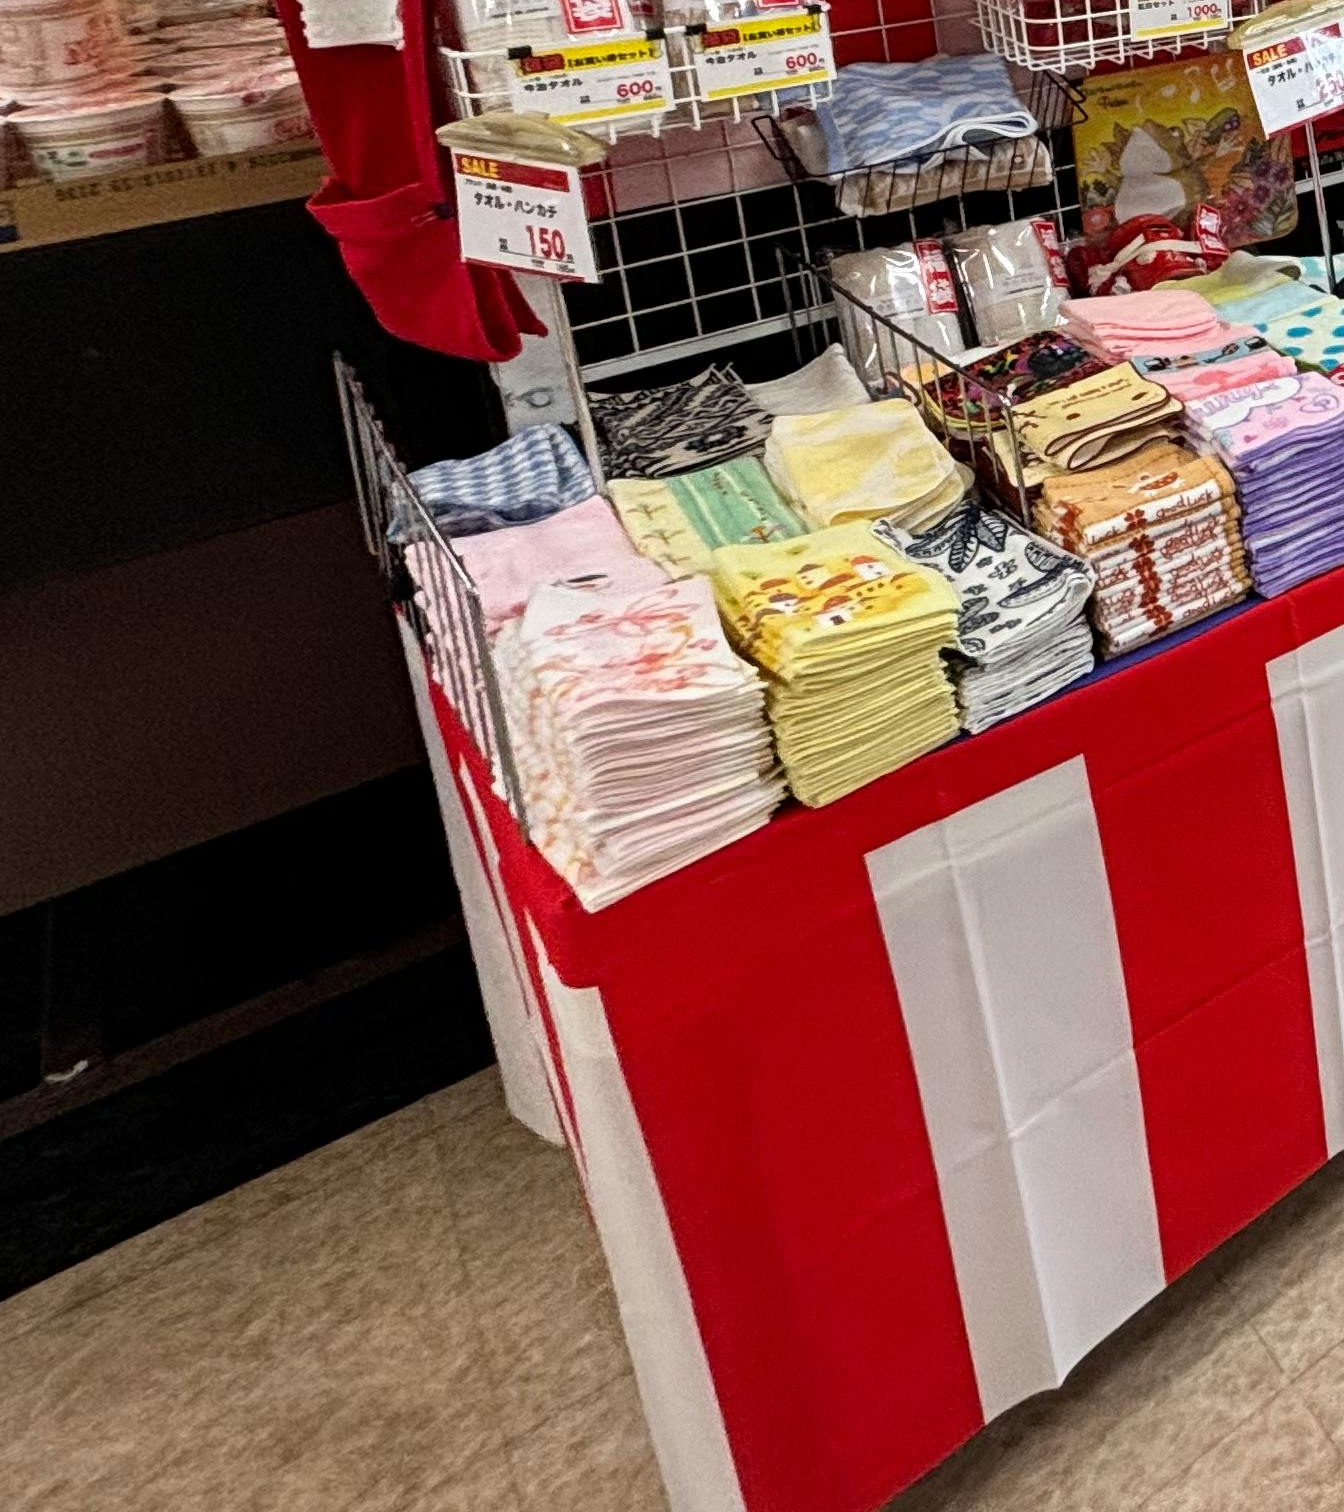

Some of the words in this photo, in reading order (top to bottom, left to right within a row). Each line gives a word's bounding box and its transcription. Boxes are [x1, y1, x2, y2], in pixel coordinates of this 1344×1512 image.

[1252, 43, 1288, 66] SALE
[461, 157, 499, 178] SALE
[474, 191, 558, 219] タオル・ハンカチ
